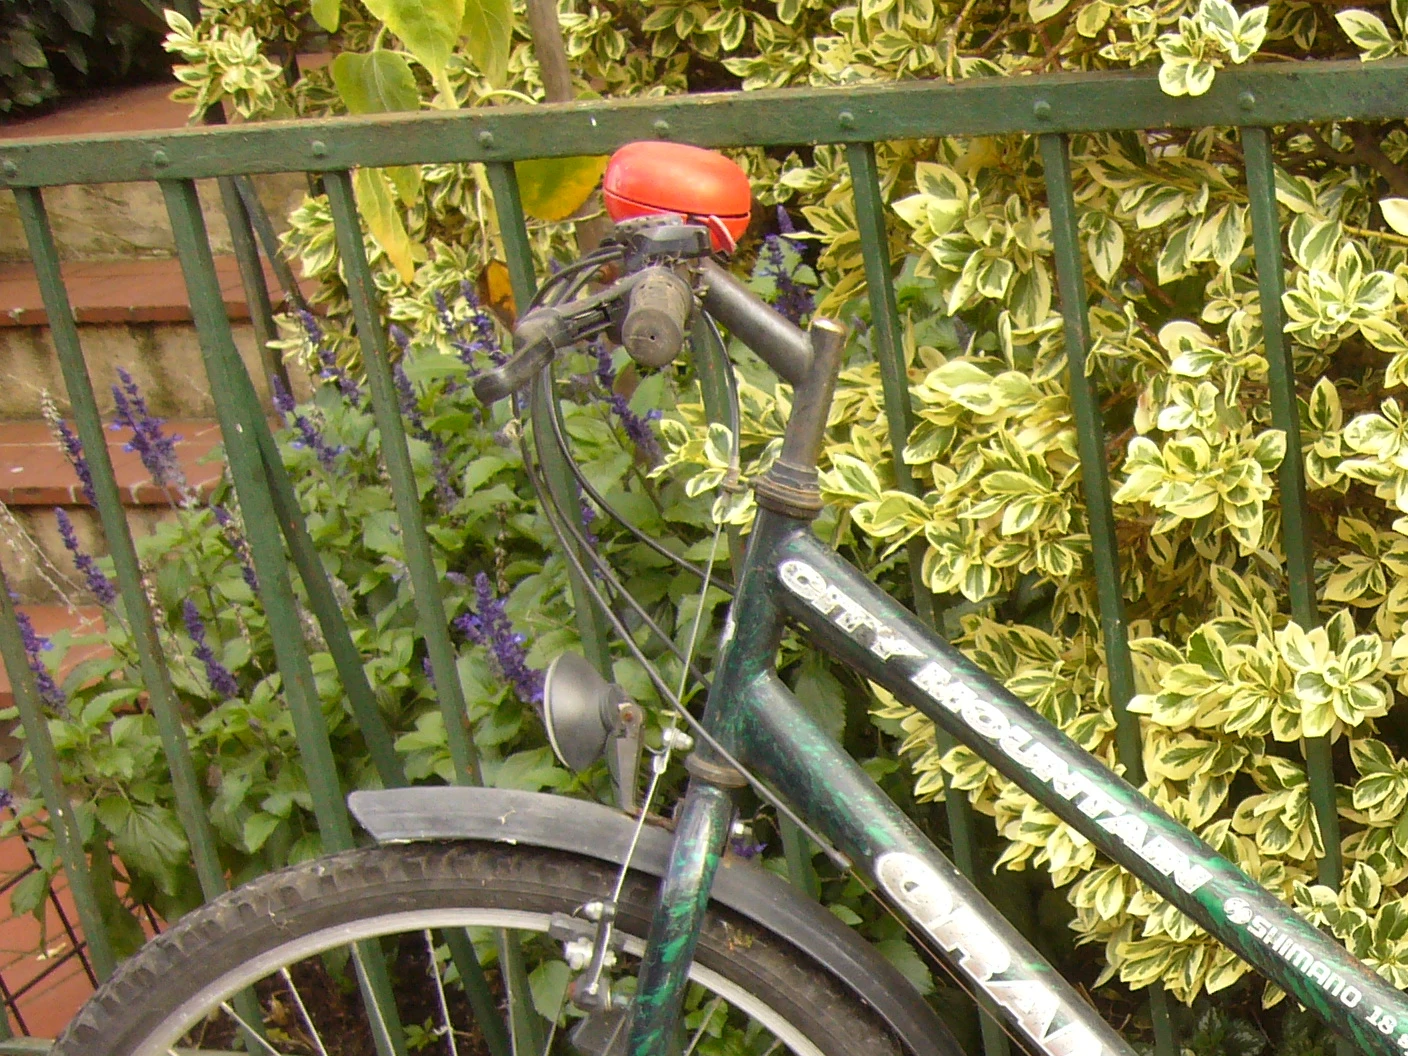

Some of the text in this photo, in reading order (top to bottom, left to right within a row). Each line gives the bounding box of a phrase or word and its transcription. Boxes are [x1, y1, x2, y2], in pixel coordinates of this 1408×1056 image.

[778, 559, 1213, 894] CITY MOUNTAIN
[1247, 918, 1362, 1009] SHIMANO
[1365, 1007, 1397, 1035] 18
